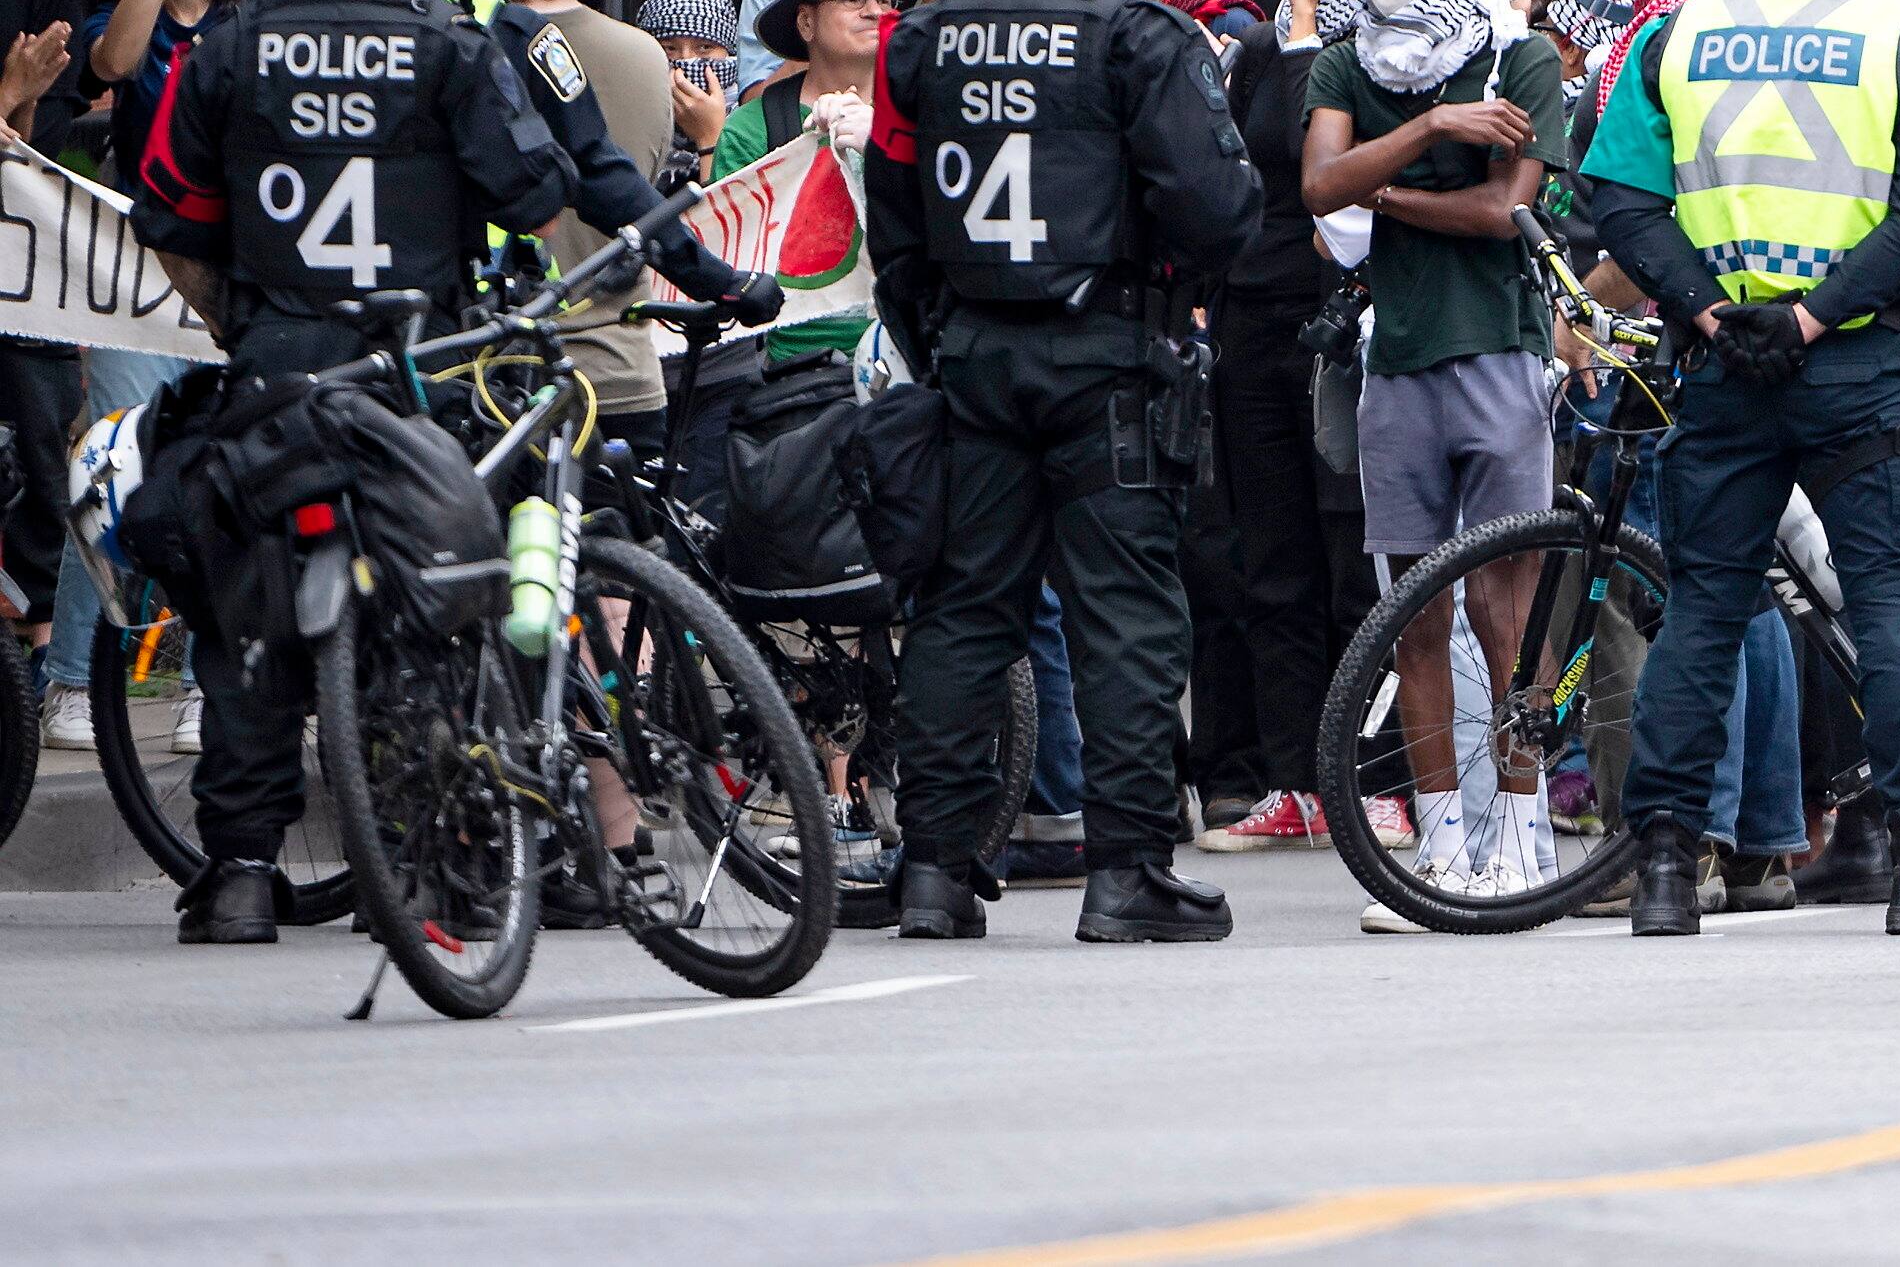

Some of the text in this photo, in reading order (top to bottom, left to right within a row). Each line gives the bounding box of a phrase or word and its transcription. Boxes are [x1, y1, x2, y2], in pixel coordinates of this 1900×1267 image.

[258, 32, 415, 80] POLICE
[936, 22, 1077, 67] POLICE
[1699, 32, 1849, 77] POLICE
[289, 91, 376, 137] SIS
[961, 79, 1037, 124] SIS
